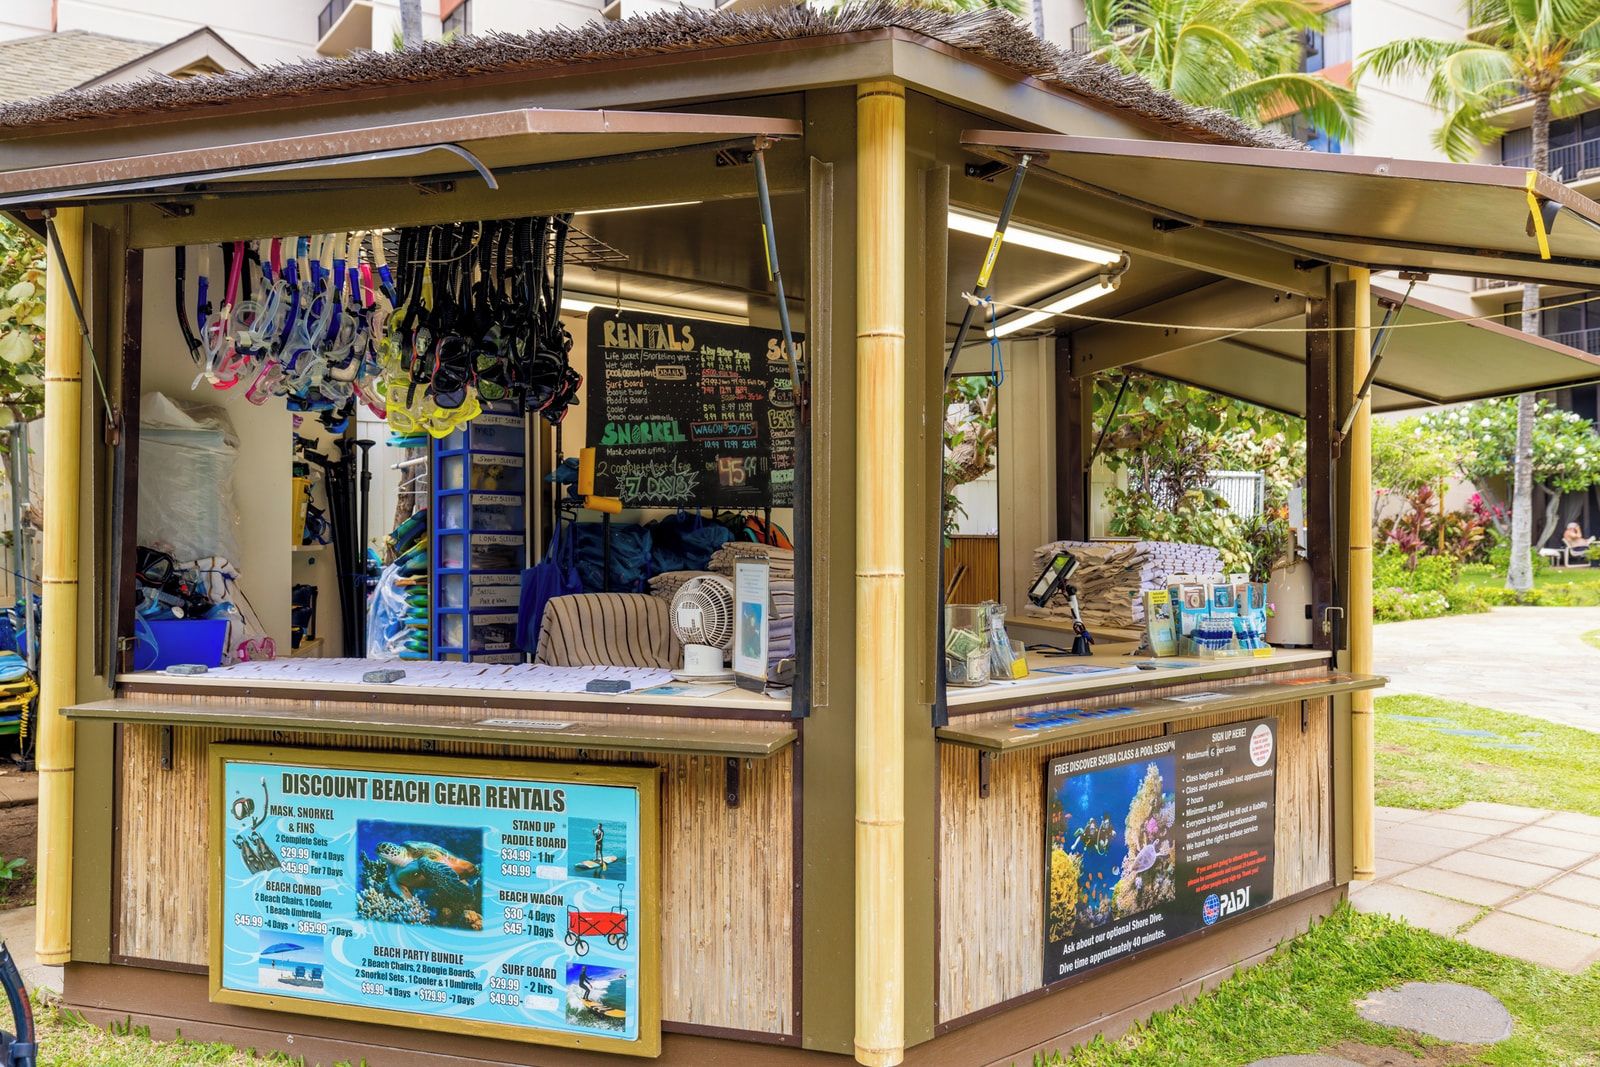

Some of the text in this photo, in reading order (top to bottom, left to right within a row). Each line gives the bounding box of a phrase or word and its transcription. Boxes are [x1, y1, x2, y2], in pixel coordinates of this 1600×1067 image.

[603, 320, 695, 351] RENTALS
[604, 351, 619, 360] Life
[606, 380, 621, 388] Surf
[601, 421, 686, 445] SNORKEL
[693, 424, 723, 434] WAGON
[597, 461, 609, 477] 2
[625, 476, 688, 497] 7 DAYS
[1212, 728, 1246, 742] SIGN UP HERE!
[1210, 748, 1215, 756] 6
[1054, 763, 1069, 775] FREE
[1070, 758, 1098, 772] DISCOVER
[1098, 754, 1117, 767] SCUBA
[1118, 750, 1134, 761] CLASS
[1135, 748, 1139, 757] &
[1140, 746, 1153, 757] POOL
[1186, 775, 1198, 783] Class
[1199, 770, 1213, 781] begins
[282, 773, 566, 812] DISCOUNT BEACH GEAR RENTALS
[1186, 786, 1198, 794] Class
[1199, 782, 1207, 790] and
[1208, 780, 1218, 790] pool
[1186, 796, 1203, 805] 2 hours
[1217, 801, 1223, 809] 10
[270, 805, 334, 820] MASK, SNORKEL
[288, 822, 315, 833] & FINS
[512, 820, 555, 832] STAND UP
[1202, 827, 1210, 835] and
[275, 834, 328, 846] 2 Complete Sets
[502, 834, 566, 849] PADDLE BOARD
[1186, 842, 1193, 850] We
[281, 847, 344, 862] $29.99 For 4 Days
[501, 848, 555, 863] $34.99 1 hr
[281, 862, 343, 877] $45.99 For 7 Days
[501, 863, 531, 877] $49.99
[266, 881, 321, 896] BEACH COMBO
[255, 893, 259, 901] 2
[260, 893, 280, 904] Beach
[281, 895, 304, 906] Chairs,
[309, 898, 333, 909] Cooler,
[500, 890, 563, 906] BEACH WAGON
[1220, 886, 1251, 917] PADI
[269, 906, 321, 919] Beach Umbrella
[528, 910, 555, 923] 4 Days
[234, 913, 353, 937] $45.99 Days $65.99 Days
[527, 925, 554, 938] 7 Days
[1063, 912, 1164, 955] Ask about our optional Shore Dive.
[373, 946, 463, 965] BEACH PARTY BUNDLE
[1059, 928, 1166, 975] Dive time approximately 40 minutes.
[361, 958, 476, 979] 2 Beach Chairs, 2 Boogie Boards,
[502, 963, 557, 980] SURF BOARD
[355, 969, 482, 991] 2 Snorkel Cooler Umbrella
[490, 976, 553, 994] $29.99 2 hrs
[361, 983, 475, 1006] $99.99 Days $129.99 Days
